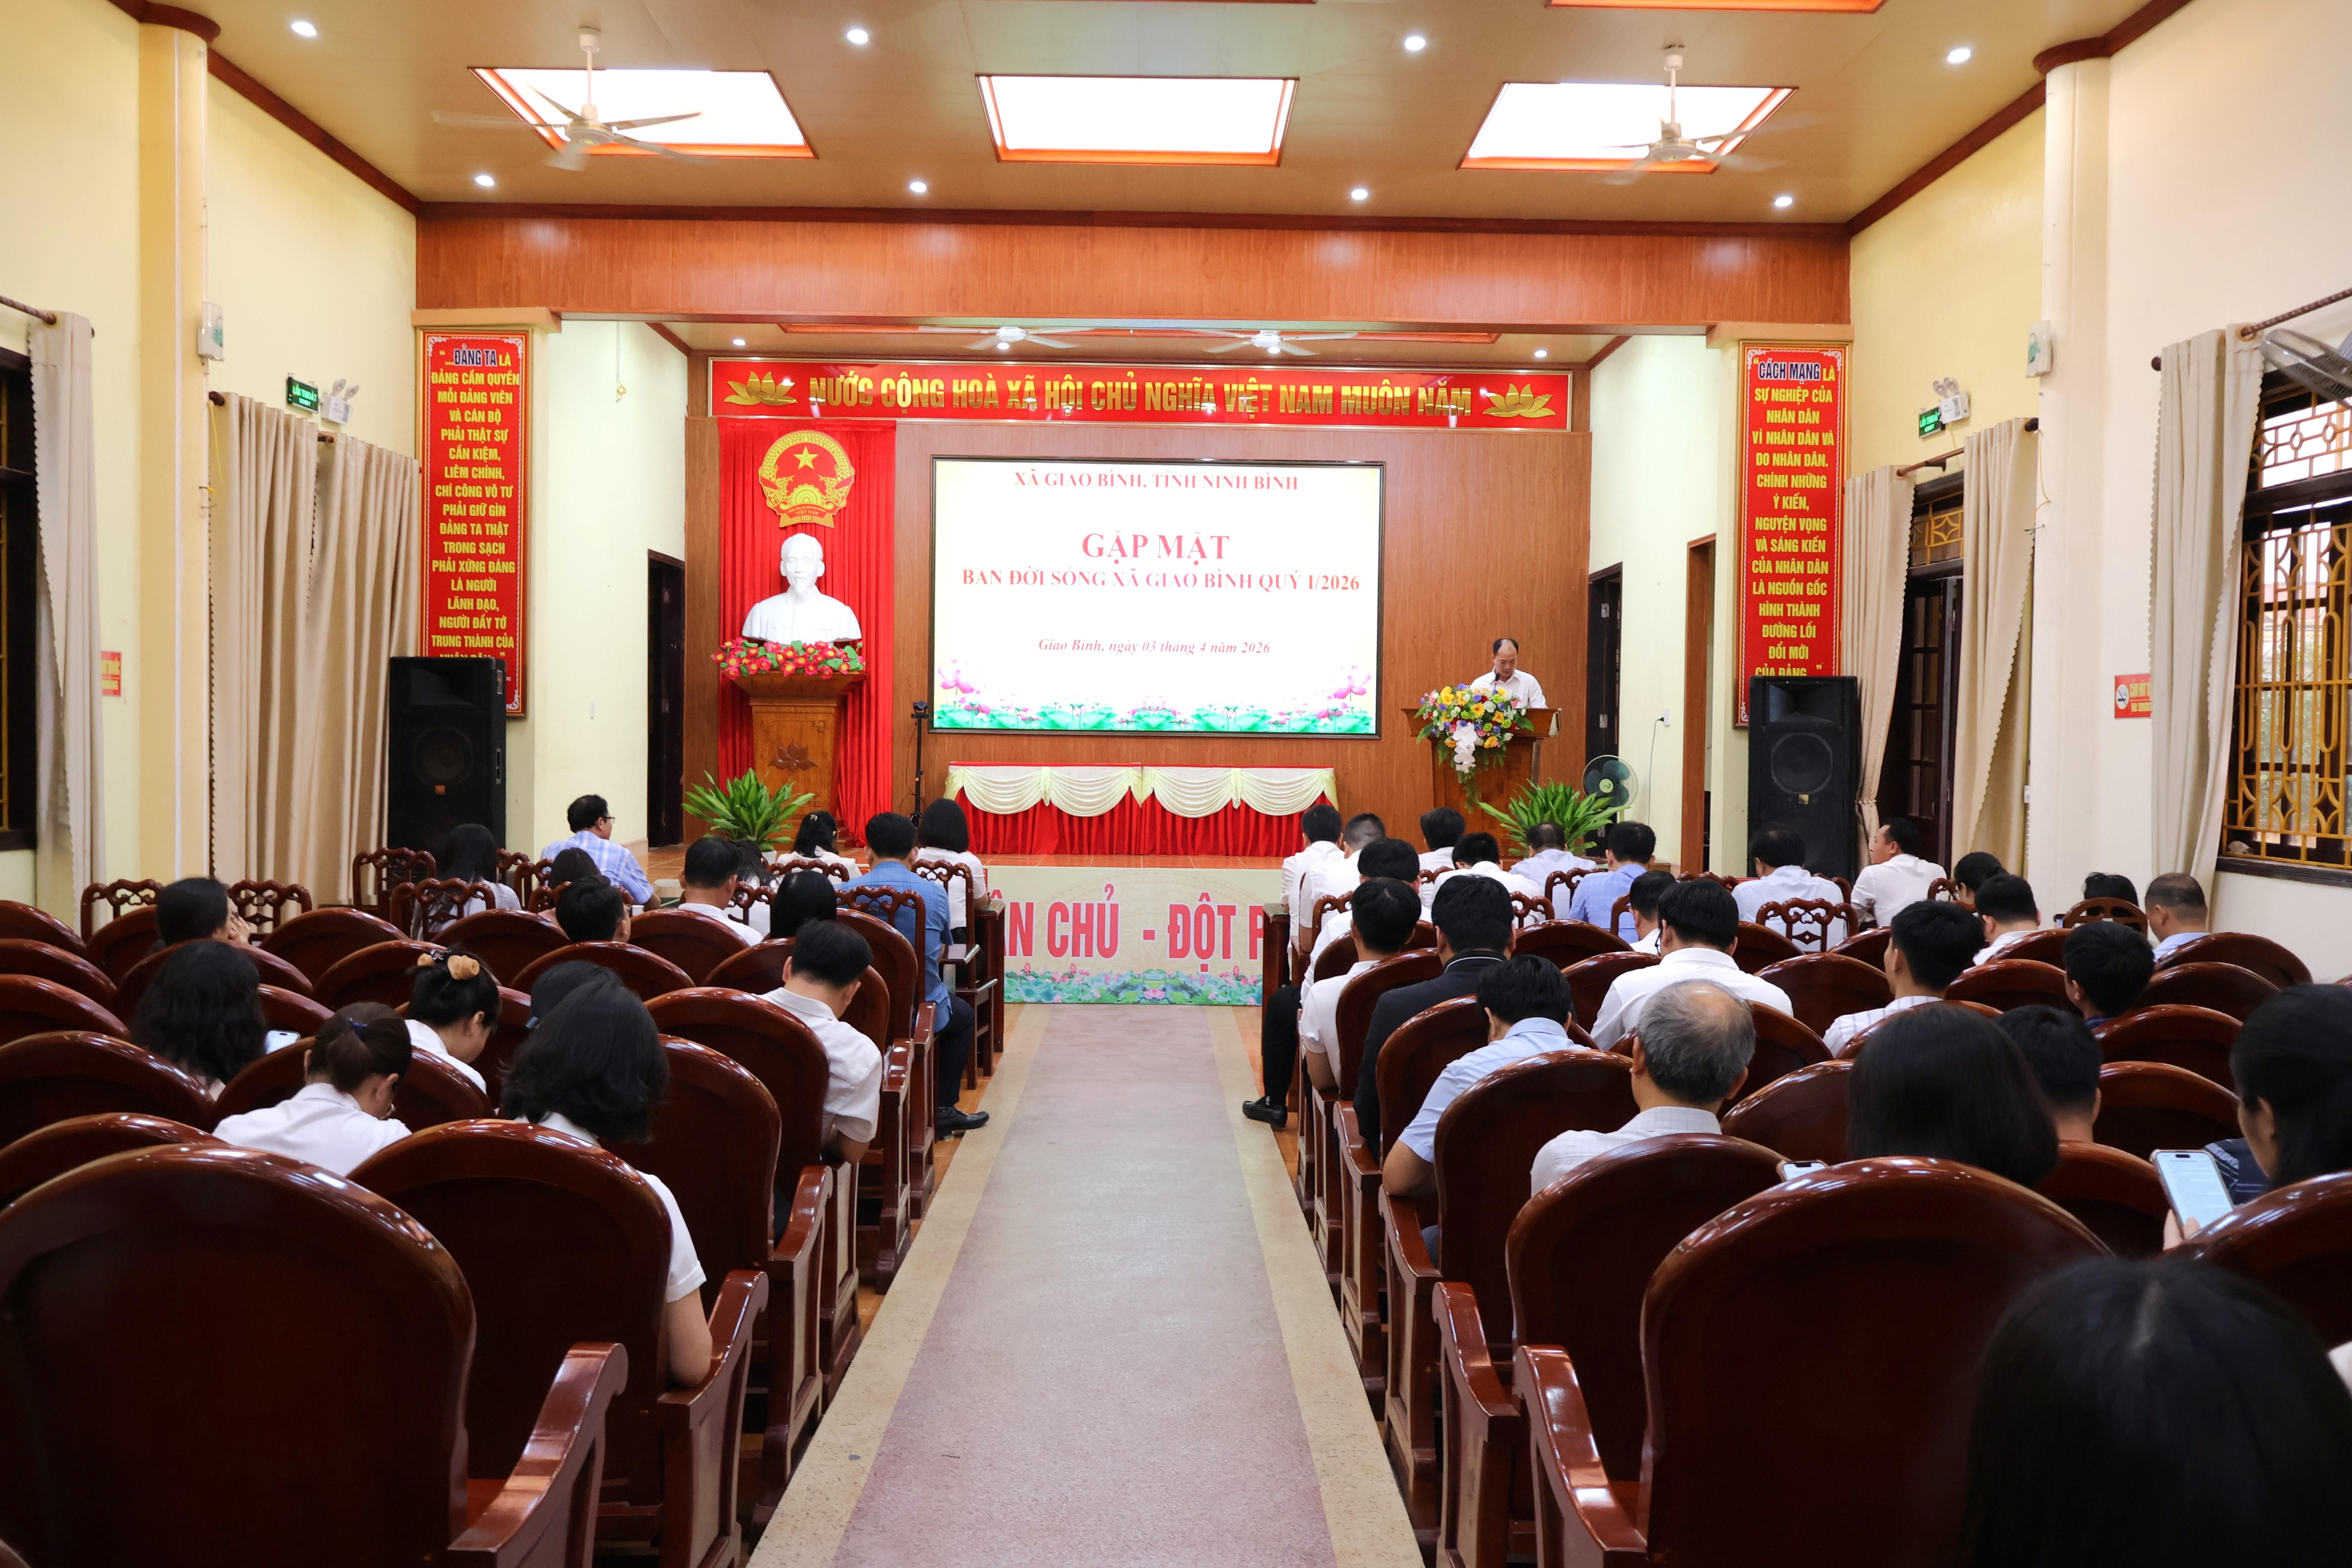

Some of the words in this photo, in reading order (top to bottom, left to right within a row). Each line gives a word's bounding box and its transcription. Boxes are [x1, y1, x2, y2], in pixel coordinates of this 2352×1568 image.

[485, 350, 496, 365] TA
[499, 353, 511, 366] LÀ
[431, 368, 459, 385] ĐẢNG
[462, 369, 485, 385] CẦM
[487, 370, 519, 387] QUYỀN
[1789, 363, 1820, 384] MẠNG
[1823, 365, 1835, 381] LÀ
[460, 388, 487, 403] ĐẢNG
[490, 390, 512, 404] VIÊN
[810, 370, 874, 406] NƯỚC
[880, 371, 945, 412] CỘNG
[952, 373, 998, 408] HOÀ
[1006, 374, 1037, 409] XÃ
[1045, 375, 1083, 415] HỘI
[1091, 371, 1137, 410] CHỦ
[1145, 376, 1216, 411] NGHĨA
[1223, 377, 1273, 419] VIỆT
[1279, 385, 1333, 414] NAM
[1341, 379, 1412, 414] MUÔN
[1418, 382, 1471, 416] NĂM
[1755, 387, 1769, 404] SỰ
[1771, 386, 1809, 405] NGHIỆP
[1812, 385, 1833, 403] CỦA
[450, 409, 461, 422] VÀ
[465, 408, 485, 422] CÁN
[488, 409, 501, 425] BỘ
[1767, 408, 1795, 423] NHÂN
[1798, 408, 1820, 424] DÂN
[441, 425, 465, 441] PHẢI
[467, 427, 492, 443] THẬT
[494, 429, 508, 444] SỰ
[1752, 428, 1762, 444] VÌ
[1766, 429, 1795, 445] NHÂN
[1798, 430, 1819, 445] DÂN
[1822, 430, 1834, 445] VÀ
[449, 444, 470, 459] CẦN
[473, 446, 501, 462] KIỆM,
[1756, 453, 1769, 466] DO
[1773, 451, 1801, 466] NHÂN
[1804, 451, 1828, 467] DÂN.
[445, 464, 468, 478] LIÊM
[472, 465, 505, 480] CHÍNH,
[1015, 469, 1038, 485] XÃ
[1045, 473, 1091, 486] GIAO
[1099, 470, 1146, 487] BÌNH,
[1203, 475, 1247, 489] NINH
[1255, 472, 1297, 490] BÌNH
[1757, 472, 1788, 488] CHÍNH
[1791, 473, 1827, 488] NHỮNG
[436, 483, 452, 497] CHÍ
[455, 483, 482, 497] CÔNG
[485, 484, 497, 498] VÔ
[500, 485, 513, 498] TƯ
[443, 501, 466, 515] PHẢI
[469, 503, 487, 516] GIỮ
[489, 503, 506, 516] GÌN
[1773, 494, 1779, 509] Ý
[1782, 493, 1809, 510] KIẾN,
[440, 519, 467, 535] ĐẢNG
[470, 523, 482, 535] TA
[485, 521, 509, 537] THẬT
[1755, 515, 1796, 533] NGUYỆN
[1799, 518, 1826, 533] VỌNG
[443, 542, 476, 554] TRONG
[479, 542, 505, 556] SẠCH
[1082, 531, 1148, 564] GẶP
[1156, 531, 1229, 566] MẶT
[1755, 536, 1768, 552] VÀ
[1771, 537, 1798, 552] SÁNG
[1802, 536, 1826, 552] KIẾN
[432, 557, 456, 572] PHẢI
[488, 559, 515, 573] ĐÁNG
[1752, 556, 1772, 573] CỦA
[1776, 558, 1804, 573] NHÂN
[1807, 559, 1828, 574] DÂN
[452, 578, 463, 591] LÀ
[466, 577, 496, 592] NGƯỜI
[963, 570, 1001, 584] BAN
[1010, 566, 1044, 585] ĐỜI
[1114, 568, 1138, 586] XÃ
[1146, 573, 1197, 587] GIAO
[1205, 569, 1251, 588] BÌNH
[1259, 570, 1300, 592] QUÝ
[1309, 575, 1359, 590] I/2026
[1753, 579, 1765, 594] LÀ
[1807, 578, 1827, 595] GỐC
[448, 596, 474, 610] LÃNH
[476, 599, 499, 612] ĐẠO,
[1759, 601, 1783, 616] HÌNH
[1786, 602, 1820, 616] THÀNH
[439, 615, 470, 628] NGƯỜI
[473, 614, 492, 628] ĐẦY
[1762, 622, 1797, 637] ĐƯỜNG
[1800, 621, 1816, 638] LỐI
[432, 635, 461, 647] TRUNG
[464, 635, 493, 647] THÀNH
[496, 633, 514, 648] CỦA
[1039, 640, 1067, 650] Giao
[1073, 640, 1103, 651] Bình,
[1109, 640, 1138, 654] ngày
[1143, 641, 1156, 651] 03
[1161, 642, 1194, 655] tháng
[1200, 643, 1205, 652] 4
[1211, 643, 1236, 652] năm
[1242, 642, 1269, 653] 2026
[1769, 641, 1786, 659] ĐỔI
[1789, 644, 1808, 659] MỚI
[1047, 883, 1119, 959] CHỦ
[1167, 892, 1236, 973] ĐỘT
